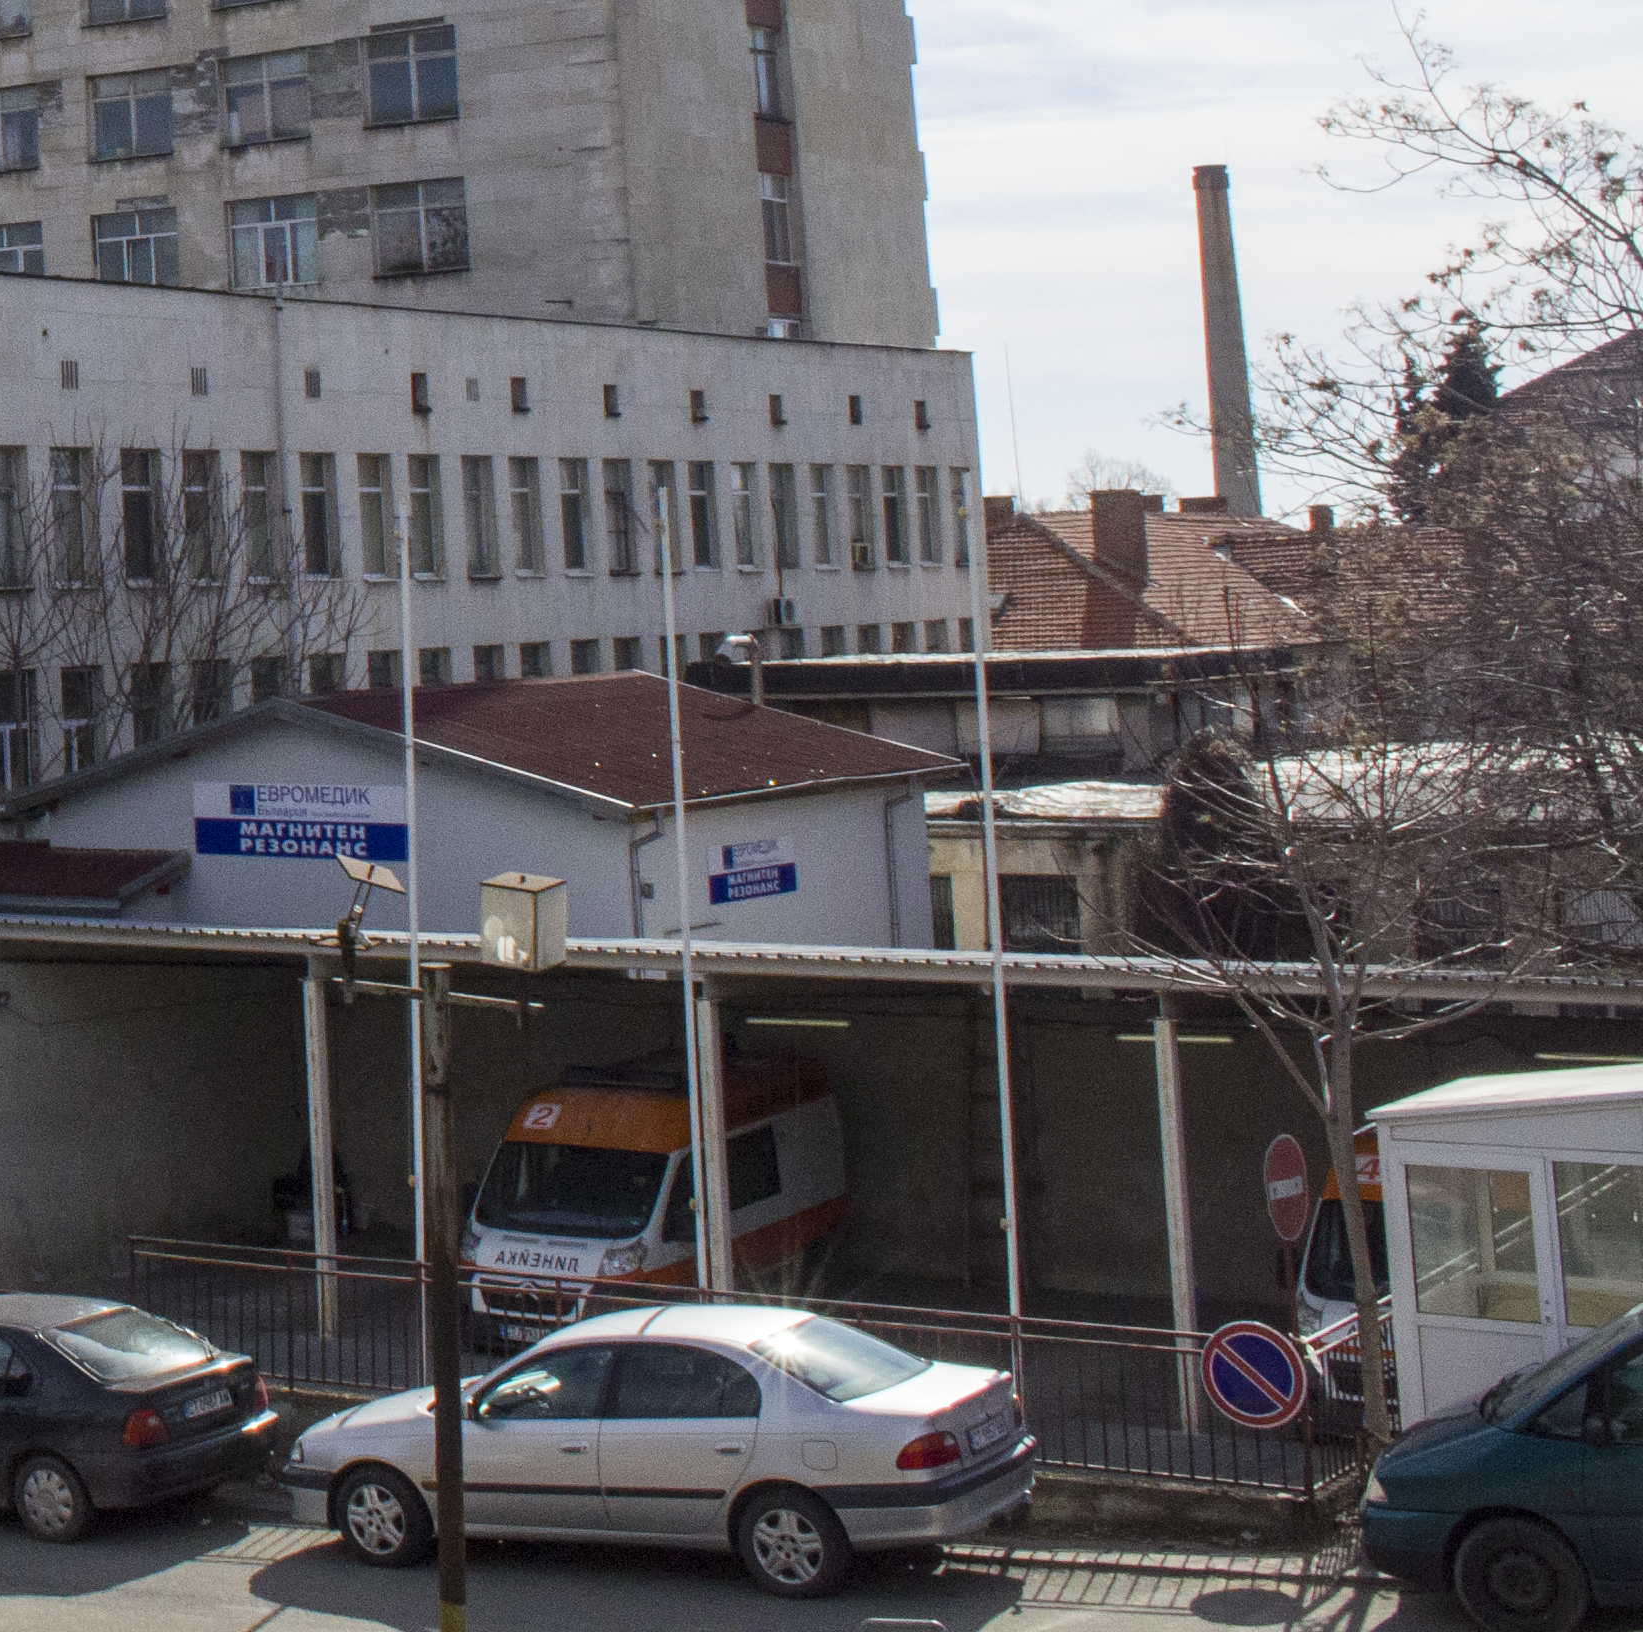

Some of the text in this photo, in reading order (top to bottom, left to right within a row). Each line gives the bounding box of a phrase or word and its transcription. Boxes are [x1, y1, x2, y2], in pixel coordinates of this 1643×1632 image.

[256, 785, 371, 806] ЕВРОМЕДИК
[240, 822, 366, 839] МАГНИТЕН
[240, 838, 367, 856] РЕЗОНАНС
[727, 867, 779, 886] МАГНИТЕН
[728, 880, 780, 899] РЕЗОНАНС
[531, 1106, 553, 1127] 2
